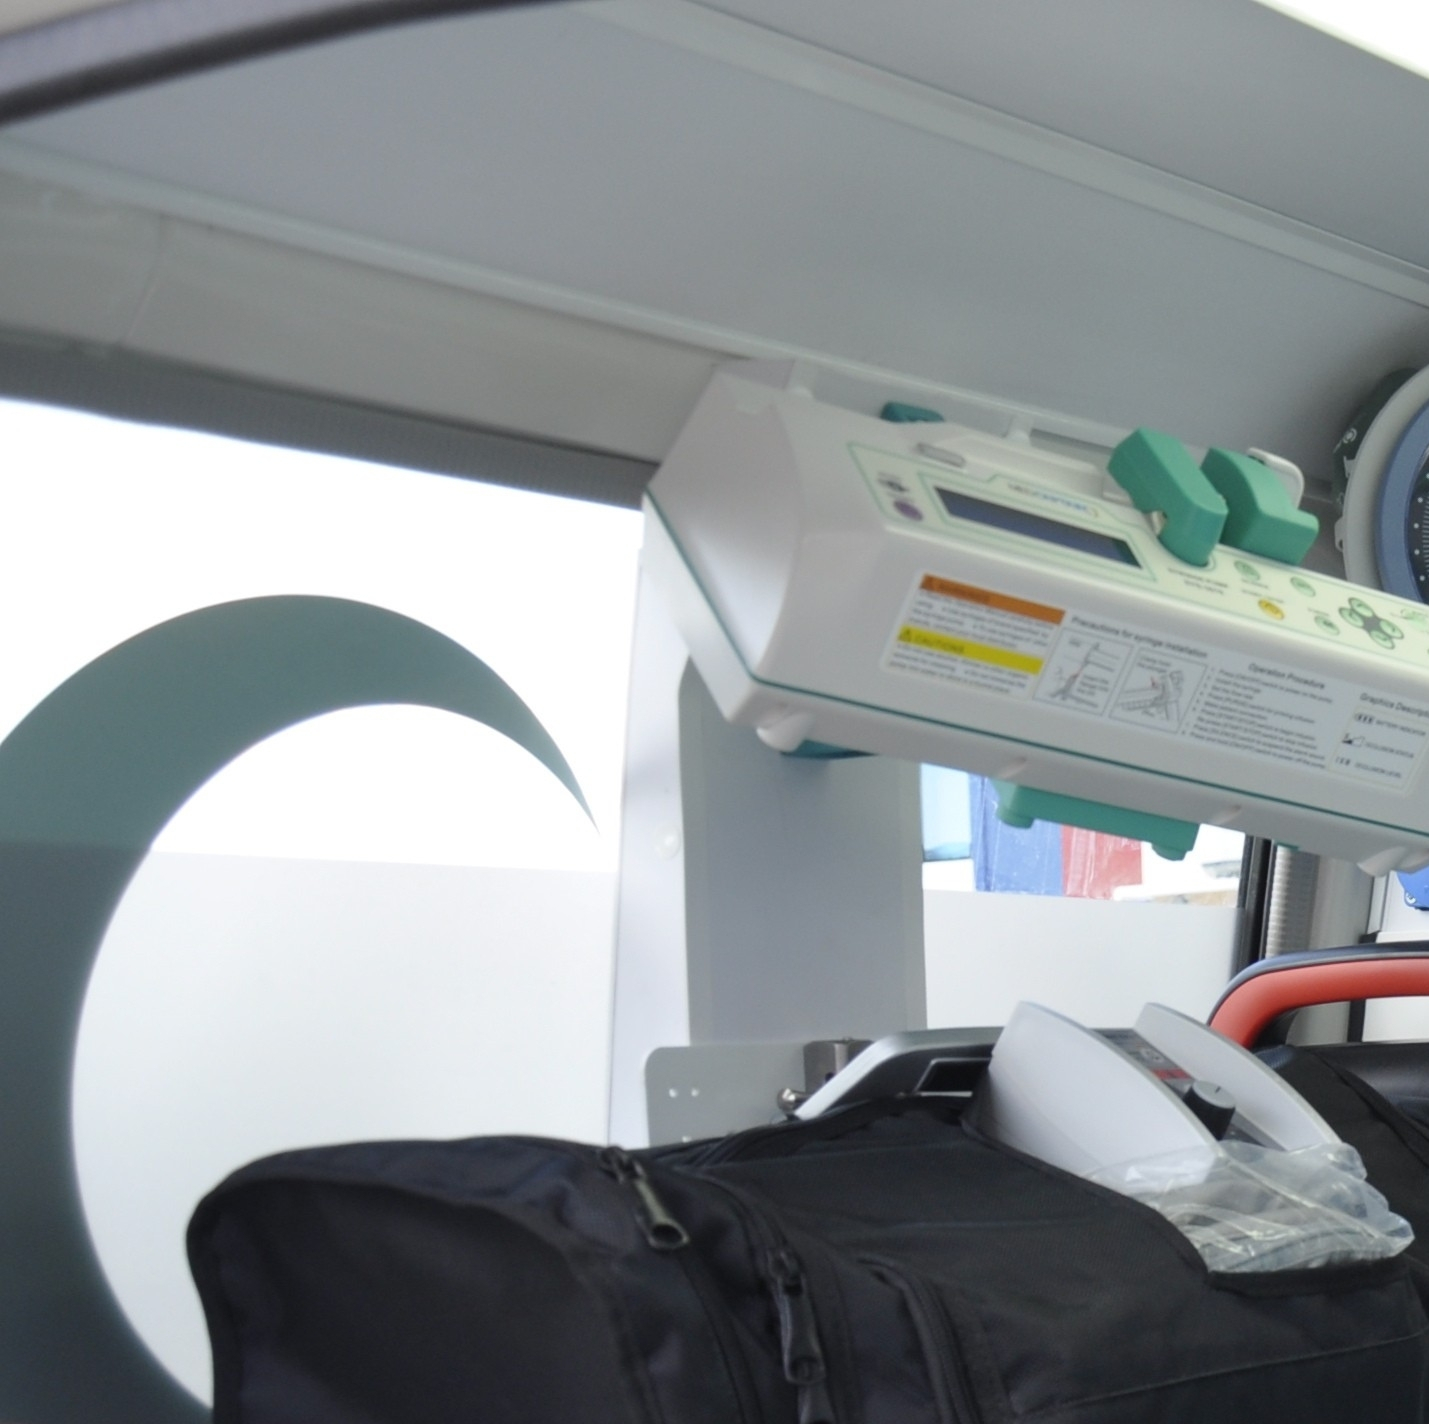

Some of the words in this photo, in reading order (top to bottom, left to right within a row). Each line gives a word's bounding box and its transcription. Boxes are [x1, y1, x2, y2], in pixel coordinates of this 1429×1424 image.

[1071, 615, 1120, 635] Precautions
[1248, 662, 1286, 678] Operation
[1287, 672, 1325, 690] Procedure
[1360, 692, 1395, 709] Graphics
